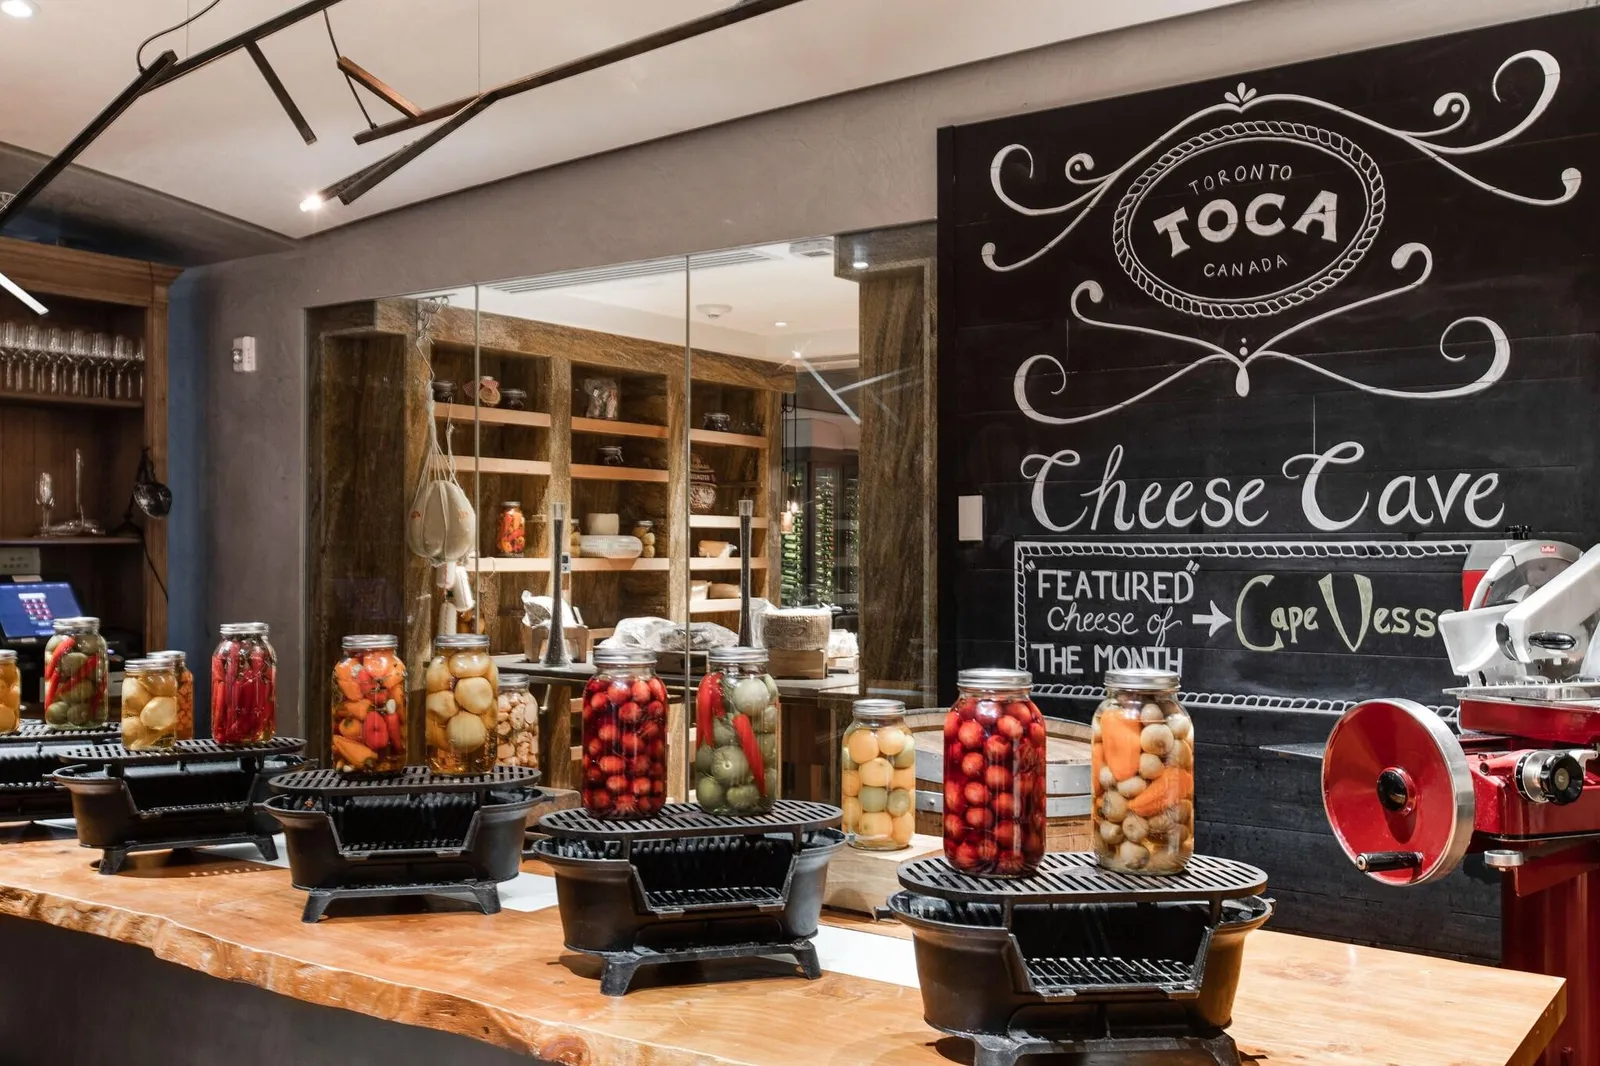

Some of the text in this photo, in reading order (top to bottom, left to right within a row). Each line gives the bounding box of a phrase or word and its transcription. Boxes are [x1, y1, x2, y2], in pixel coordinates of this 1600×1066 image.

[1188, 164, 1292, 195] TORONTO
[1153, 190, 1337, 257] TOCA
[1203, 255, 1288, 277] CANADA
[1020, 441, 1505, 532] Cheese Cave
[1146, 606, 1183, 647] of
[1235, 573, 1456, 652] Cape Vess
[1031, 643, 1183, 677] THE MONTH
